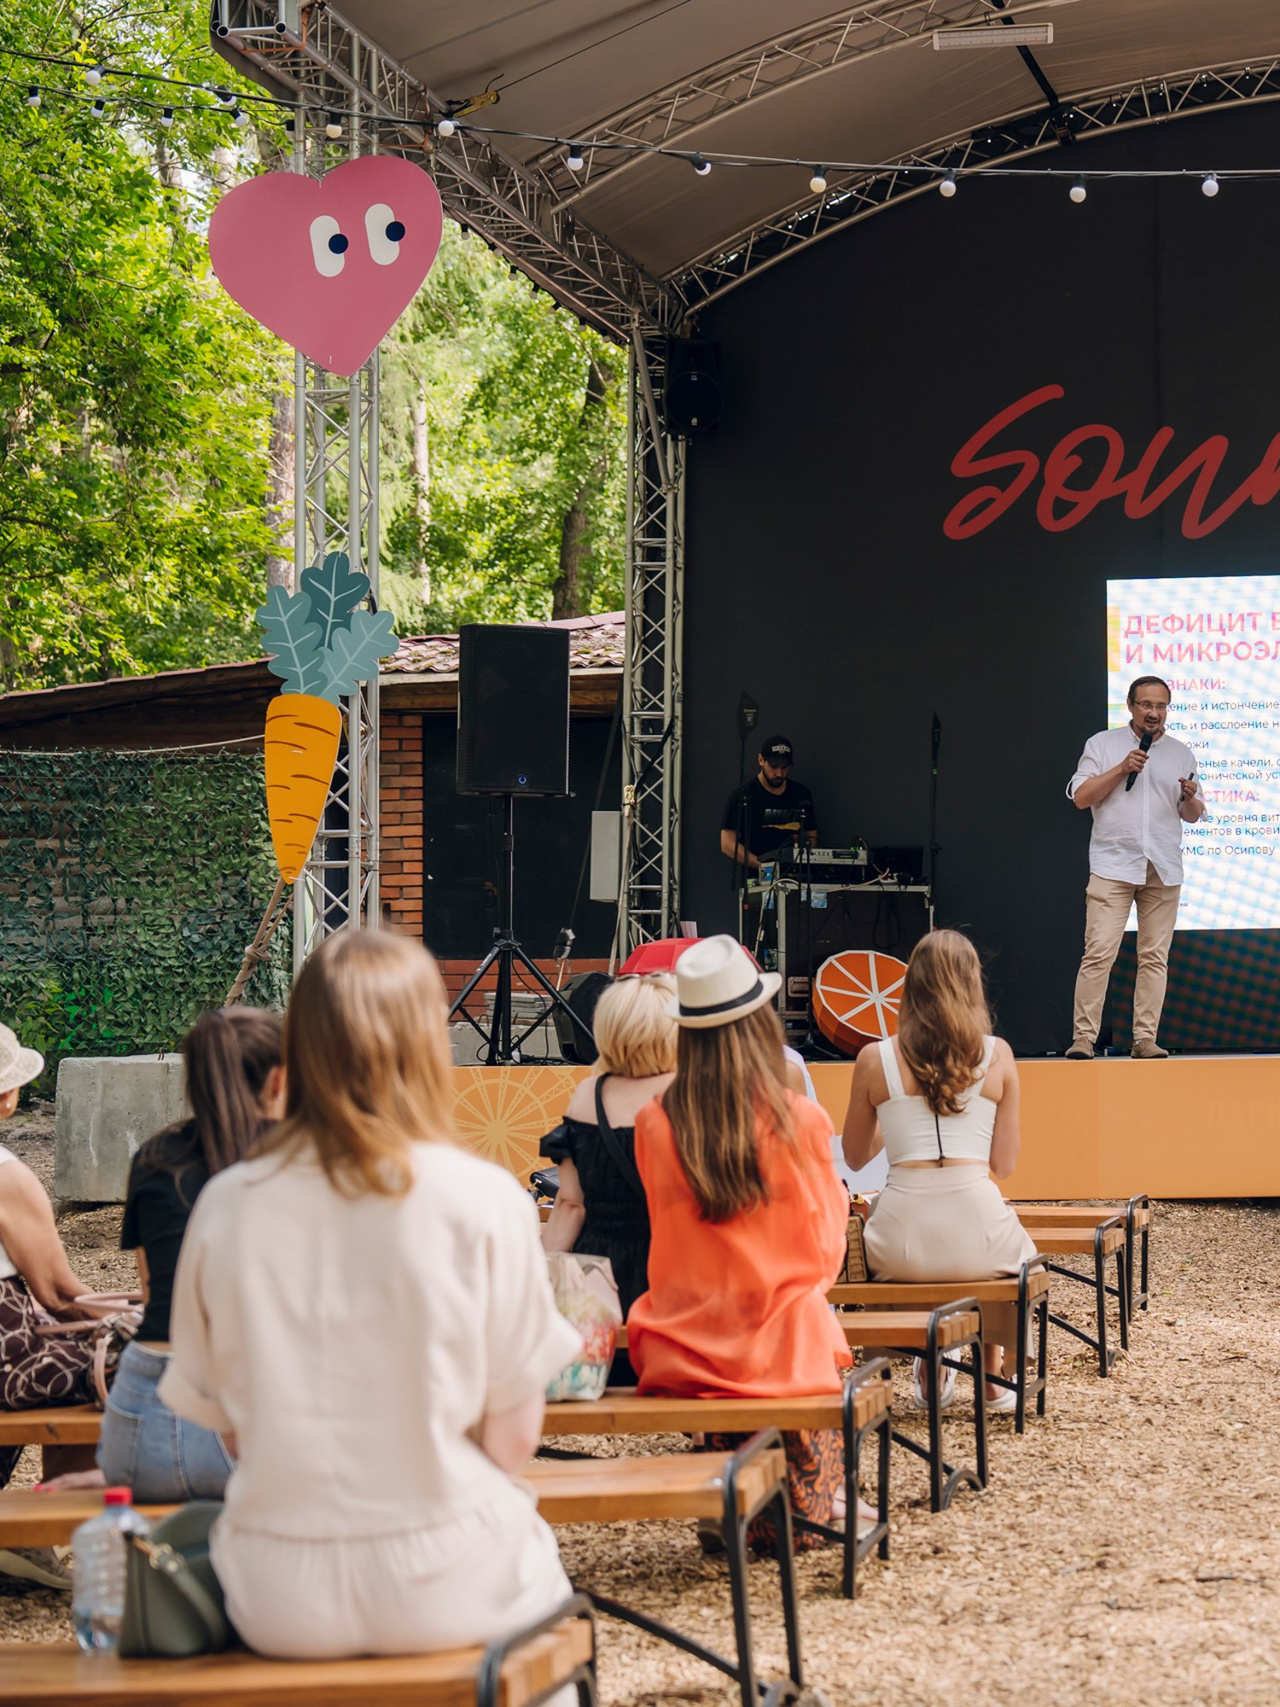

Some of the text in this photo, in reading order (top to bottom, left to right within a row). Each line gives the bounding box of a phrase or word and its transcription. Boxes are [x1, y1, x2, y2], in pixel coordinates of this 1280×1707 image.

[1124, 612, 1262, 638] ДЕФИЦИТ
[1126, 643, 1143, 664] И
[1166, 678, 1226, 691] ЗНАКИ:
[1201, 703, 1208, 711] и
[1211, 702, 1280, 710] истончение
[1190, 722, 1197, 730] и
[1201, 720, 1269, 732] расслоение
[1186, 741, 1209, 749] ожи
[1230, 759, 1274, 768] качели,
[1199, 769, 1263, 781] онической
[1216, 814, 1258, 825] уровня
[1235, 827, 1242, 836] в
[1244, 827, 1280, 837] крови
[1207, 847, 1222, 856] по
[1224, 845, 1276, 857] Осипову
